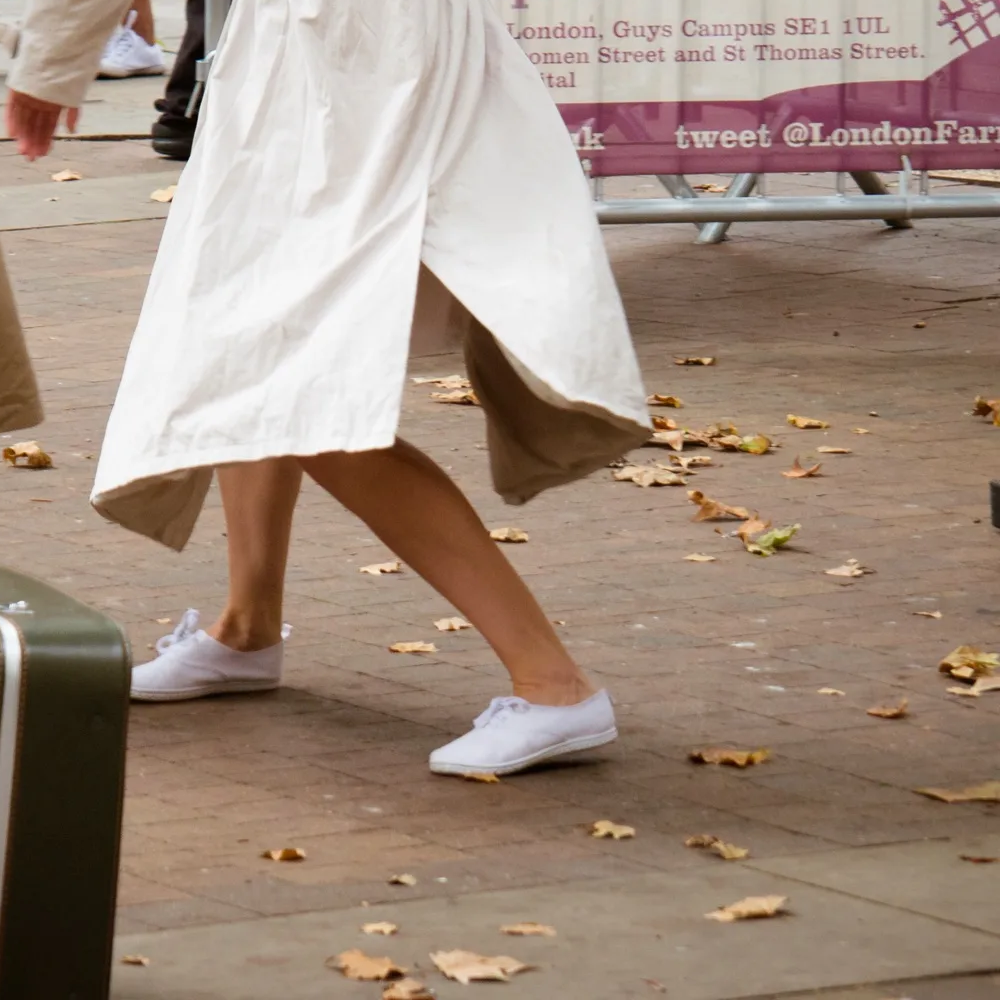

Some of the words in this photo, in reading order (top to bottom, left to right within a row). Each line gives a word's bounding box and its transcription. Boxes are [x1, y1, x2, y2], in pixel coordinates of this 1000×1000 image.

[506, 22, 604, 41] London,
[613, 21, 673, 42] Guys
[682, 19, 776, 41] Campus
[784, 18, 829, 35] SE1
[843, 17, 890, 34] 1UL
[598, 47, 665, 63] Street
[674, 46, 716, 62] and
[723, 44, 746, 62] St
[754, 44, 843, 61] Thomas
[850, 43, 925, 59] Street.
[675, 124, 771, 149] tweet
[783, 119, 1000, 148] @LondonFar
